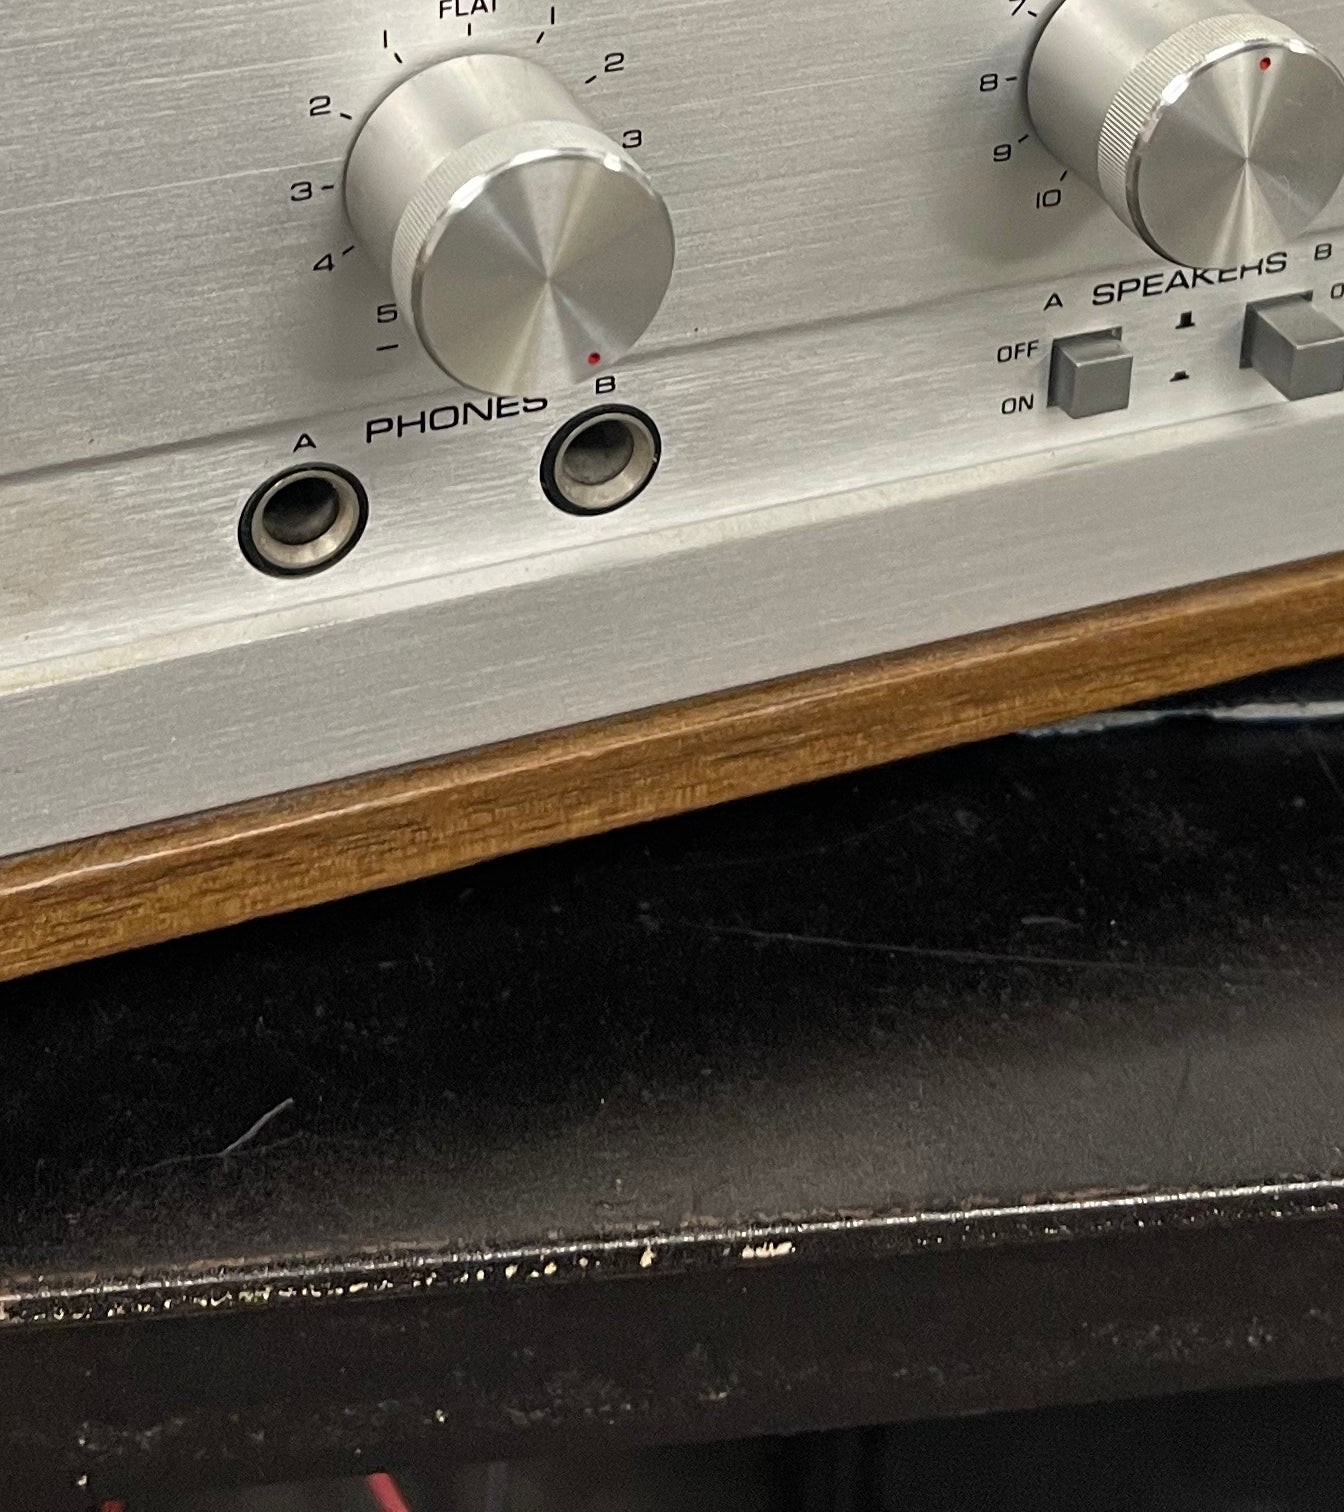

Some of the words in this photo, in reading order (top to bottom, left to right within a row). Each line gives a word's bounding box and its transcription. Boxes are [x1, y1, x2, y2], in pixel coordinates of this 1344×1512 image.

[604, 52, 625, 73] 2
[979, 73, 999, 93] 8
[309, 95, 331, 117] 2
[620, 127, 643, 150] 3
[993, 143, 1012, 163] 9
[290, 181, 313, 202] 3
[1036, 189, 1062, 209] 10
[312, 253, 335, 272] 4
[1043, 293, 1063, 311] A
[1314, 243, 1332, 261] B
[377, 303, 398, 324] 5
[997, 339, 1039, 363] OFF
[292, 433, 317, 453] A
[595, 375, 616, 395] B
[1001, 393, 1034, 415] ON
